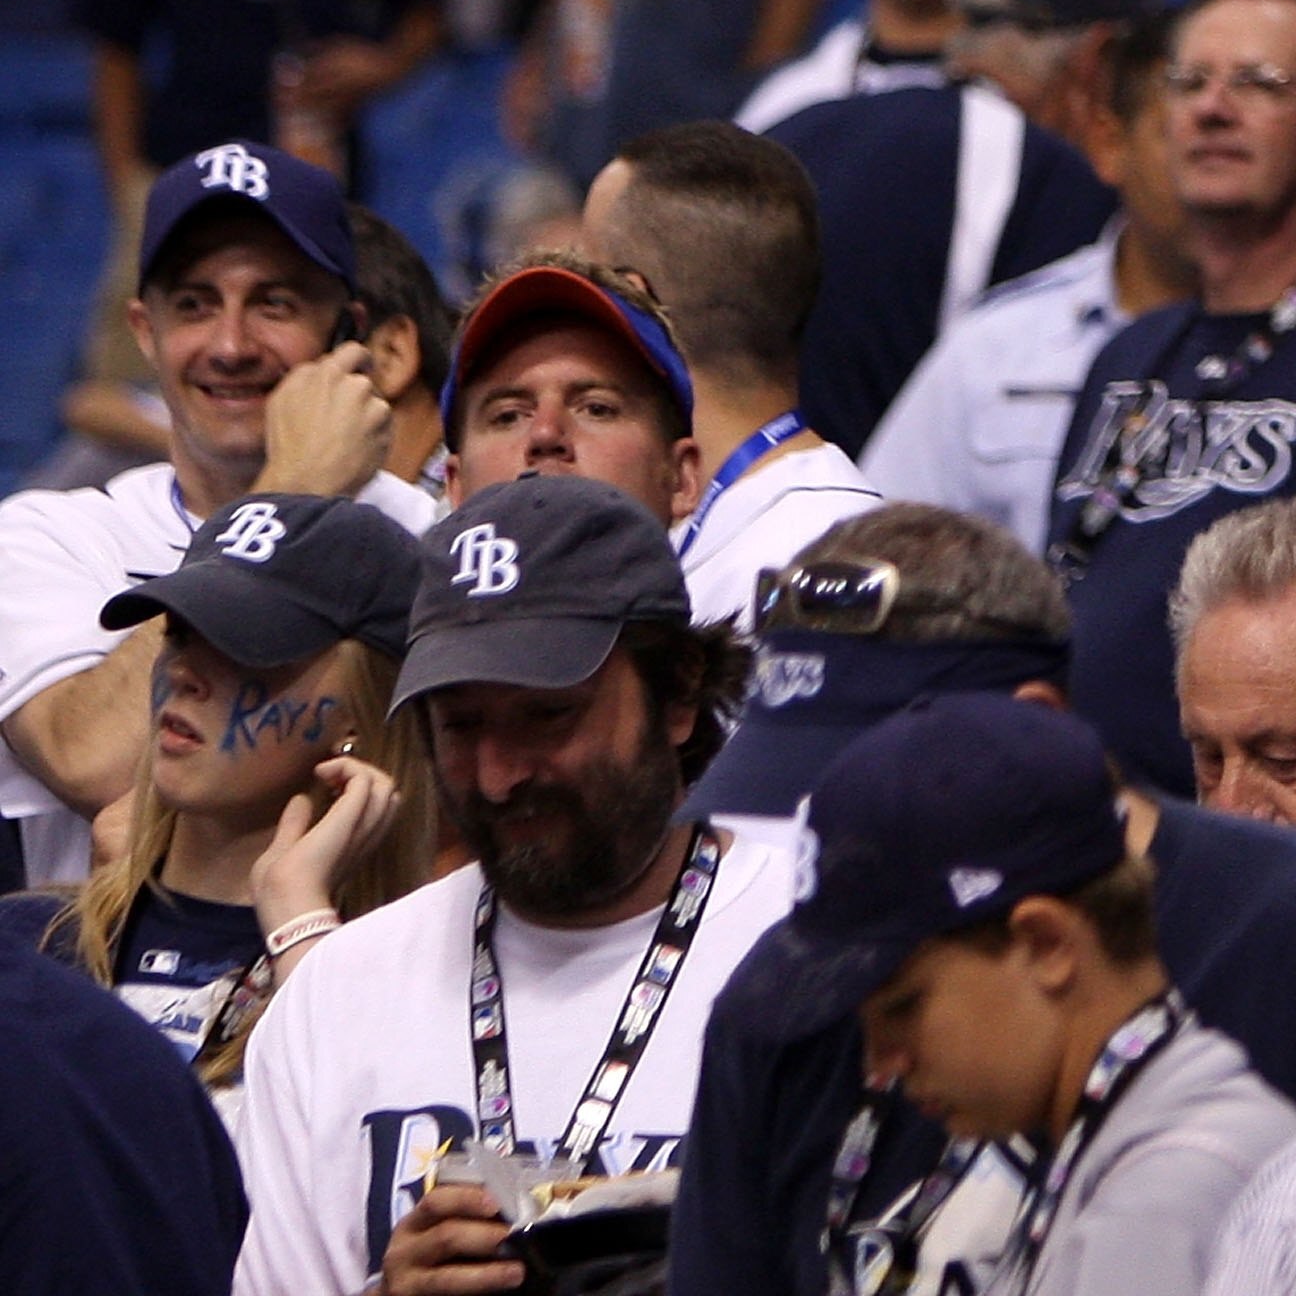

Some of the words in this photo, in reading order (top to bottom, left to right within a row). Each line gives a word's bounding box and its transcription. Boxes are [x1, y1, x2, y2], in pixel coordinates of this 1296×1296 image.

[194, 142, 271, 201] TB
[213, 500, 288, 565] TB
[450, 522, 521, 599] TB
